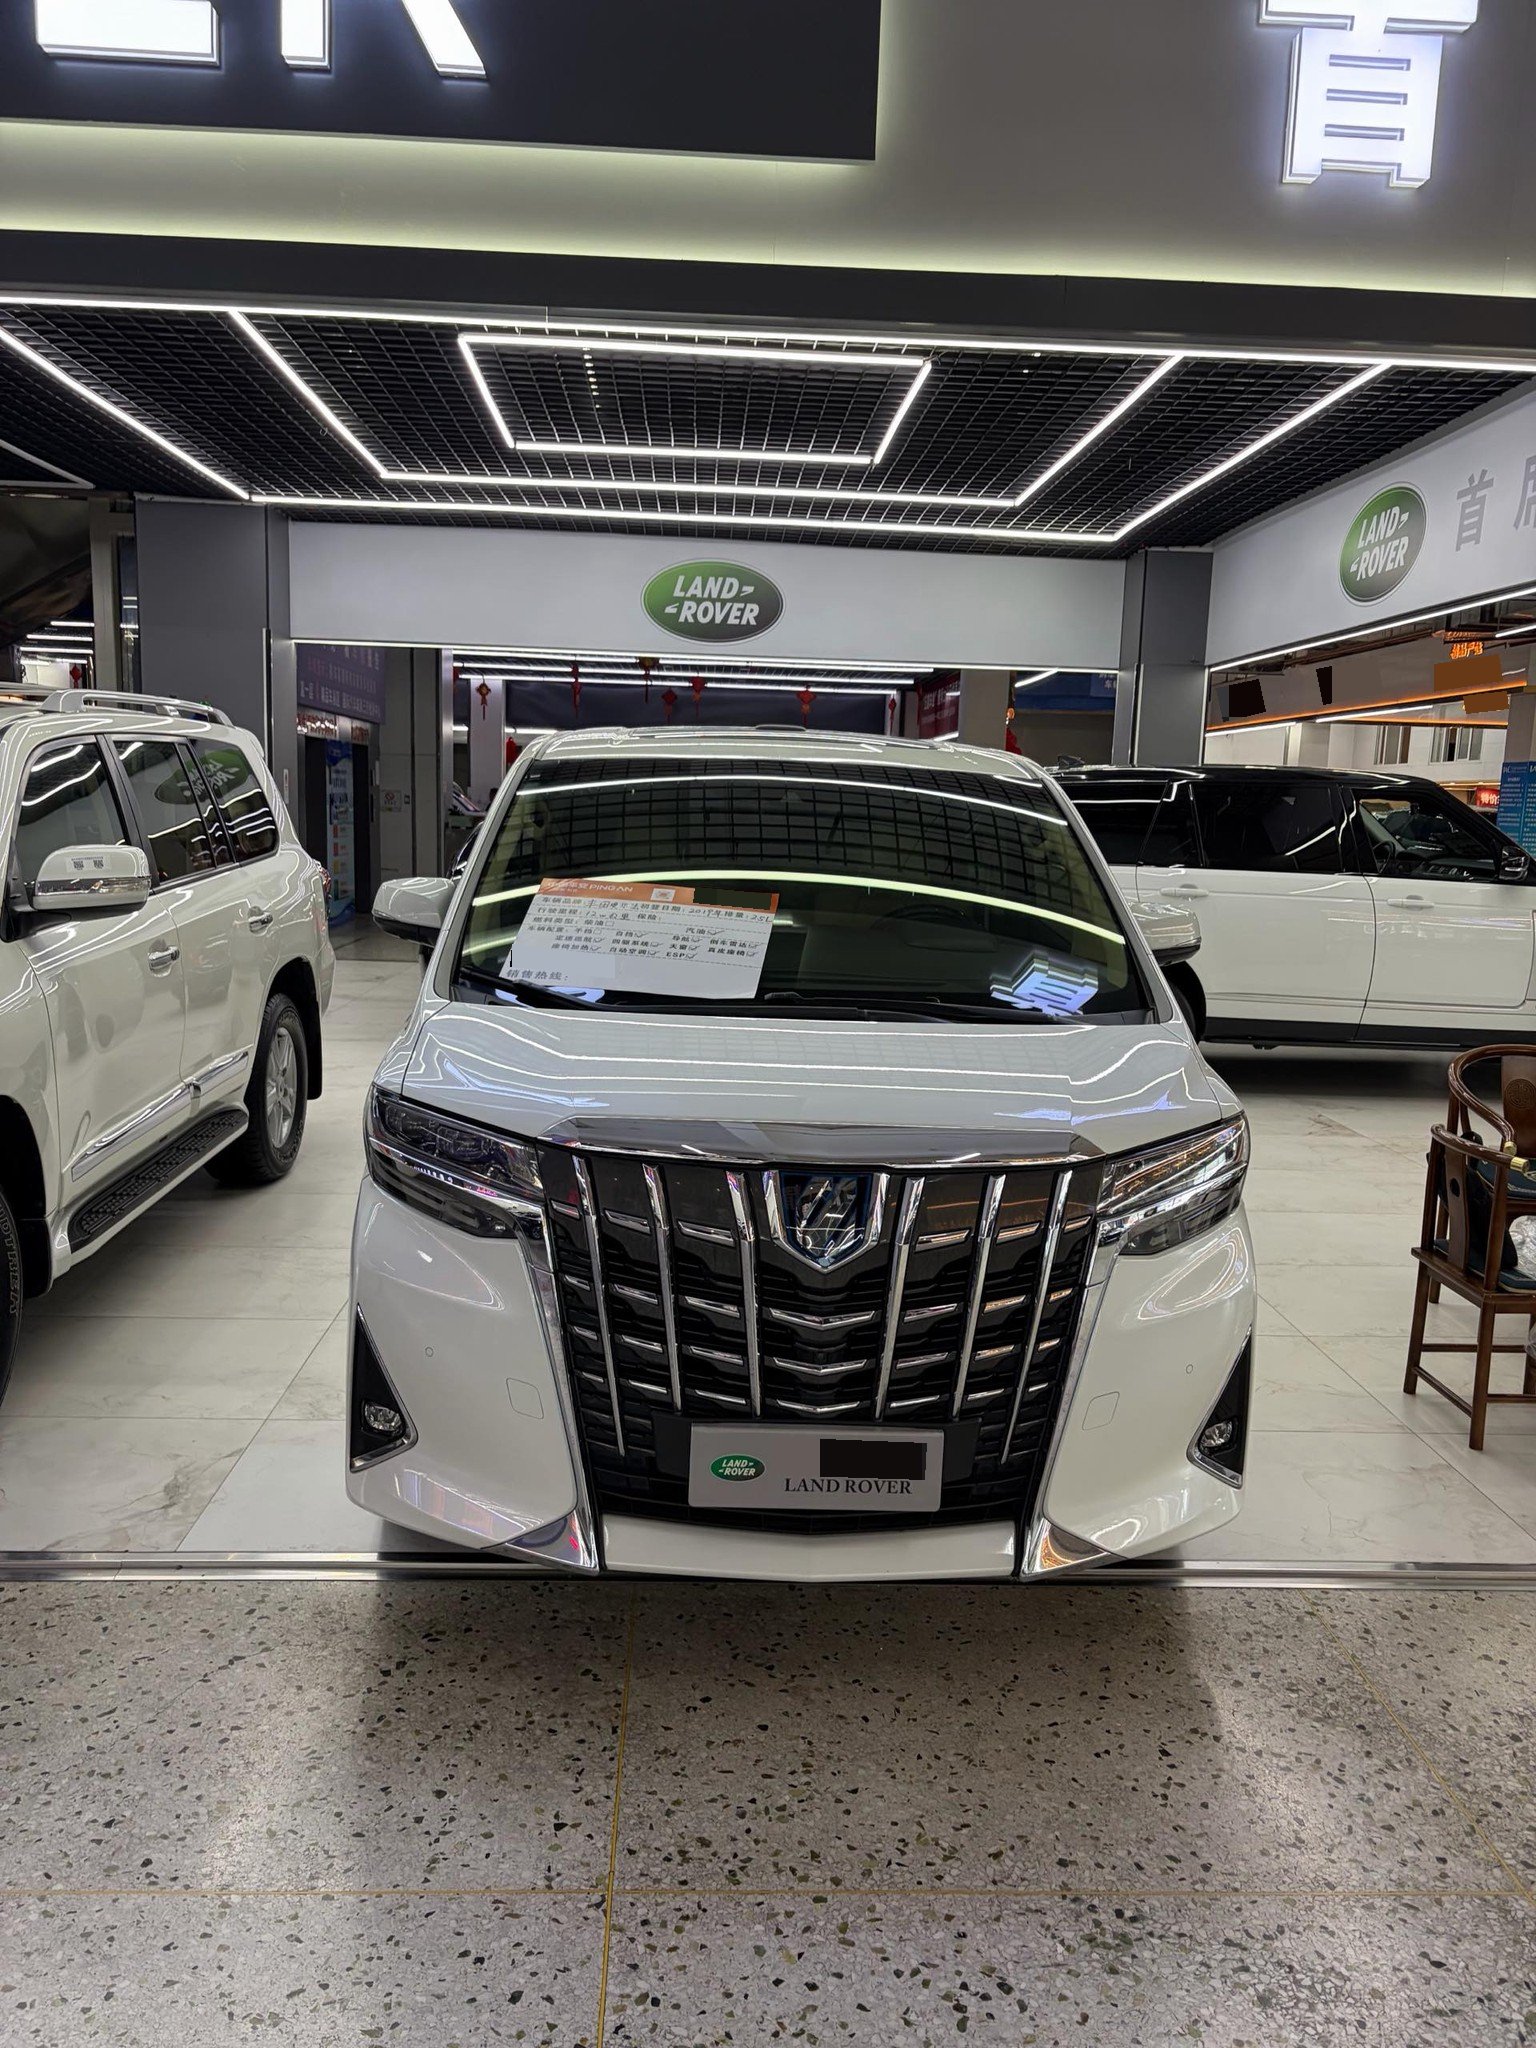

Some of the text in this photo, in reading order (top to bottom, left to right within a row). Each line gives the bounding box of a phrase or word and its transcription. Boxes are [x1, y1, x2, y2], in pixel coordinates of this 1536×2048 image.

[1357, 506, 1400, 549] LAND
[1356, 536, 1409, 581] ROVER
[673, 575, 739, 599] LAND
[678, 601, 760, 625] ROVER
[722, 1459, 748, 1468] LAND
[723, 1467, 756, 1477] ROVER
[784, 1478, 912, 1495] LAND ROVER
